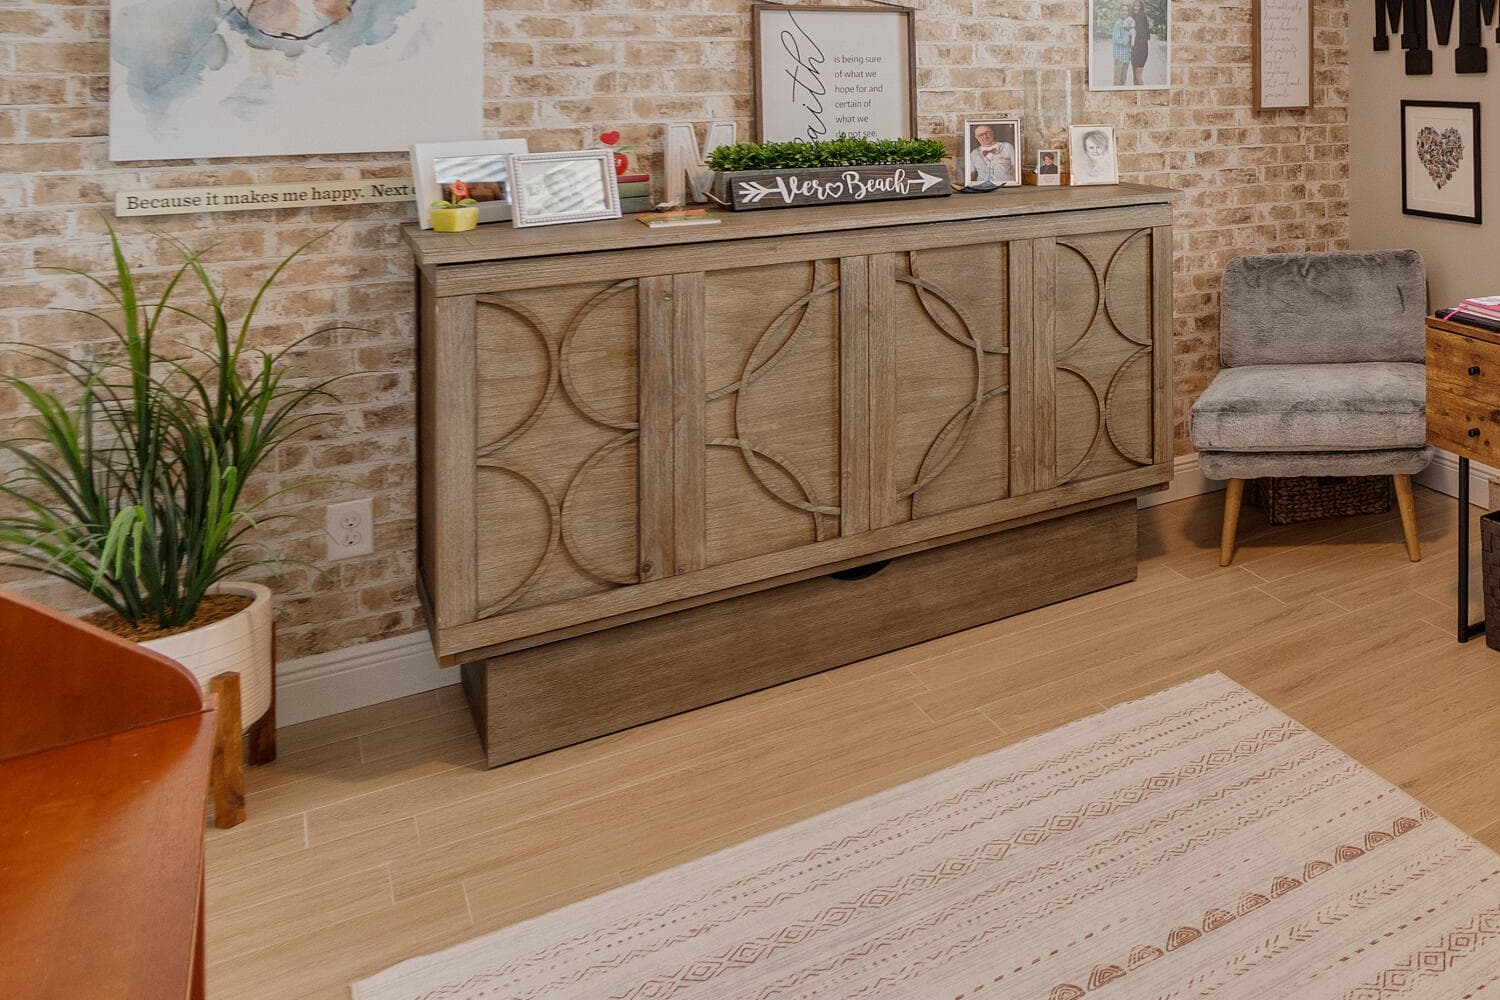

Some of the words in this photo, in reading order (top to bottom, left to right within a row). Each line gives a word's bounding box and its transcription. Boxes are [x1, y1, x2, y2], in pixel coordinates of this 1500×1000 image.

[842, 55, 864, 65] being
[780, 10, 827, 144] aith
[834, 70, 843, 78] of
[844, 70, 864, 78] what
[834, 85, 855, 94] hope
[856, 85, 867, 93] for
[868, 85, 883, 93] and
[834, 100, 862, 108] certain
[863, 99, 871, 108] of
[835, 115, 855, 123] what
[835, 130, 846, 138] do
[848, 130, 861, 138] not
[842, 168, 909, 200] Beach
[126, 195, 201, 211] Because
[206, 192, 219, 206] it
[223, 188, 279, 206] makes
[282, 189, 308, 202] me
[310, 186, 365, 203] happy.
[371, 184, 410, 198] Next
